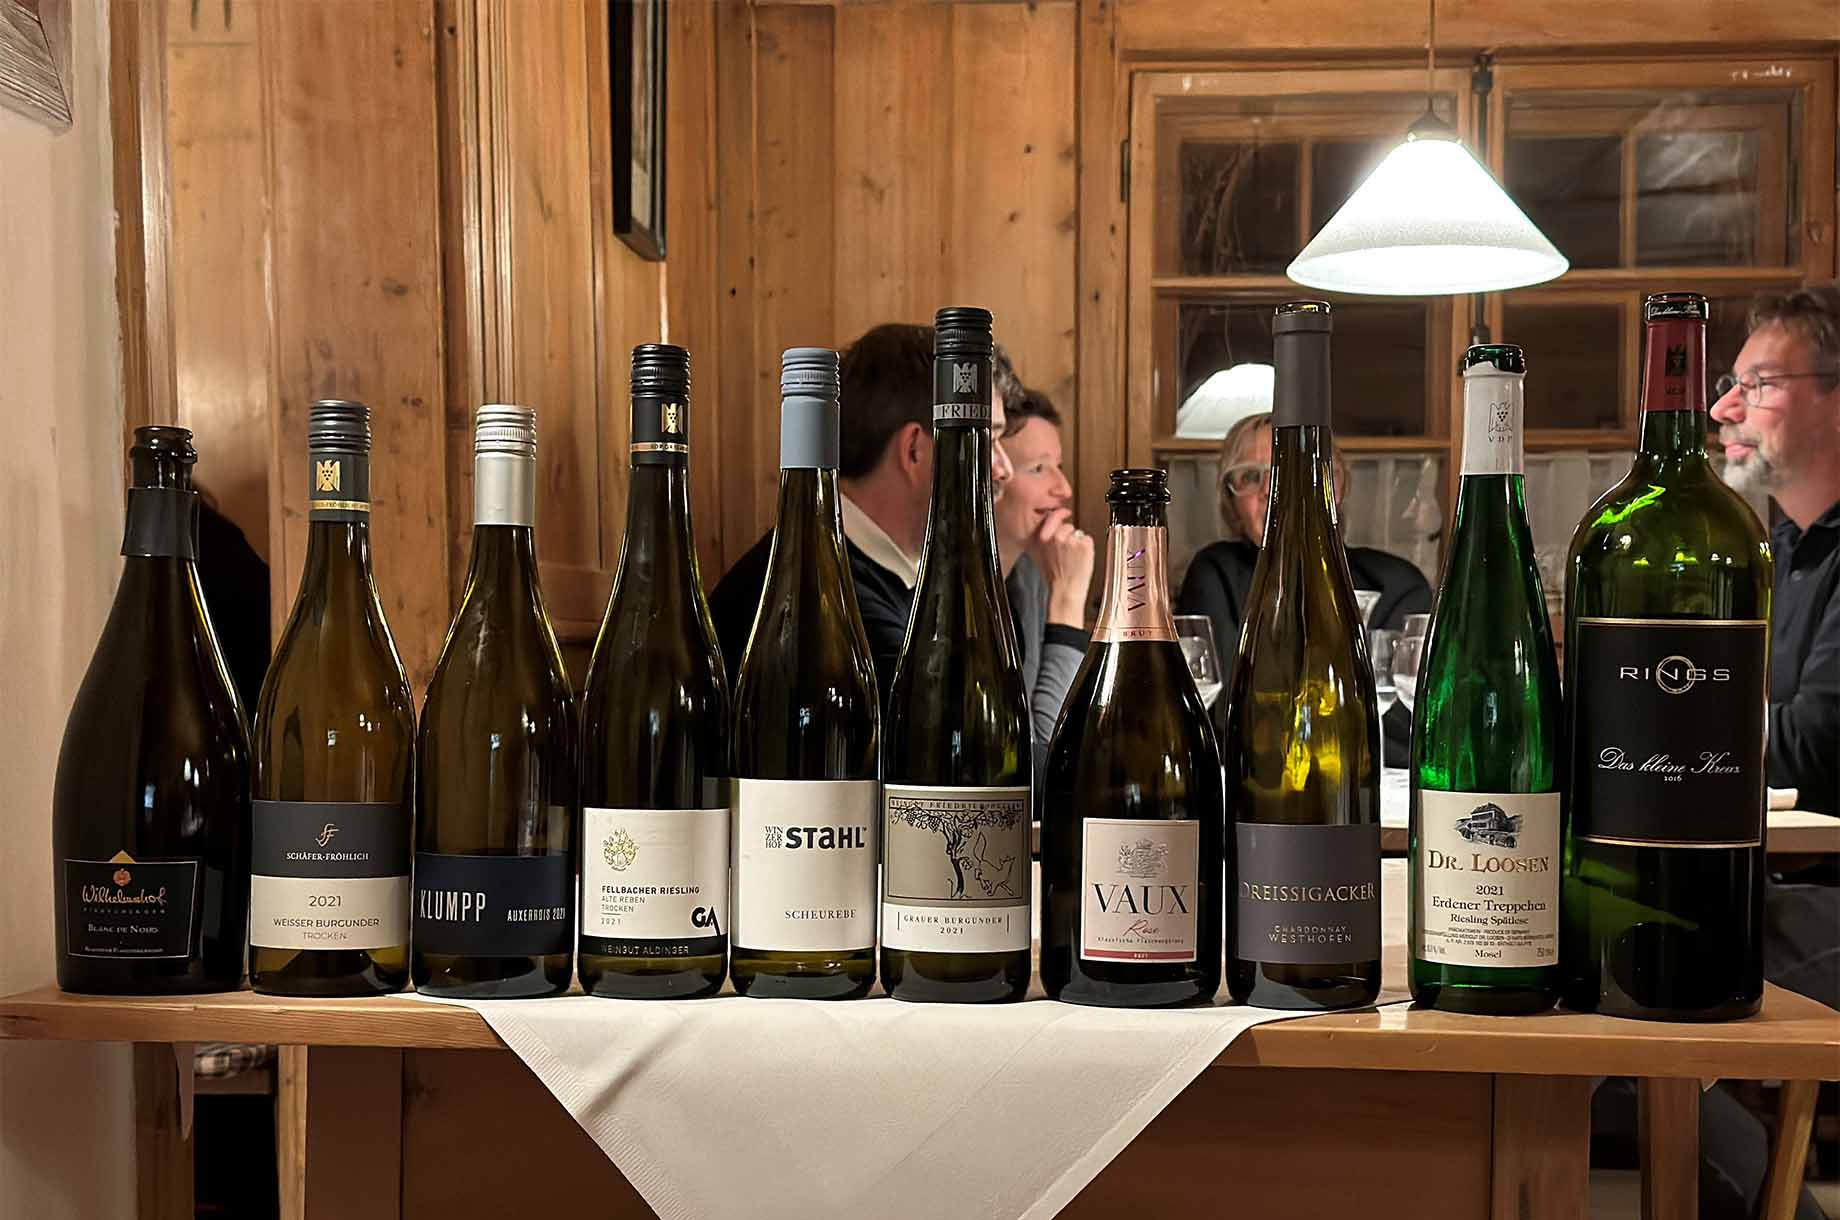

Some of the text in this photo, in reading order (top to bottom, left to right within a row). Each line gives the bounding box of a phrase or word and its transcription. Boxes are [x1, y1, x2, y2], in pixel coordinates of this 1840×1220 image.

[1598, 747, 1634, 771] Das
[1638, 754, 1687, 773] kleine
[765, 826, 784, 834] WIN
[765, 841, 783, 849] HOF
[1471, 853, 1549, 873] LOOSEN
[602, 885, 700, 895] FELLBACHER RIESLING
[1476, 885, 1504, 896] 2021
[309, 895, 342, 907] 2021
[619, 896, 645, 904] REBEN
[1091, 883, 1190, 915] VAUX
[420, 889, 566, 922] KLUMPP AUXERROIS 2021
[602, 904, 634, 912] TROCKEN
[1432, 896, 1546, 913] Erdener Treppchen
[785, 909, 857, 920] SCHEUREBE
[903, 914, 1003, 924] GRAUER BURGUNDER
[1451, 913, 1529, 925] Riesling Spätlese
[273, 918, 380, 928] WEISSER BURGUNDER
[601, 917, 621, 925] 2021
[1274, 925, 1347, 934] CHARDONNAY
[303, 932, 348, 940] TROCKEN
[1268, 934, 1352, 943] WESTHOFEN
[1474, 949, 1502, 958] Mosel
